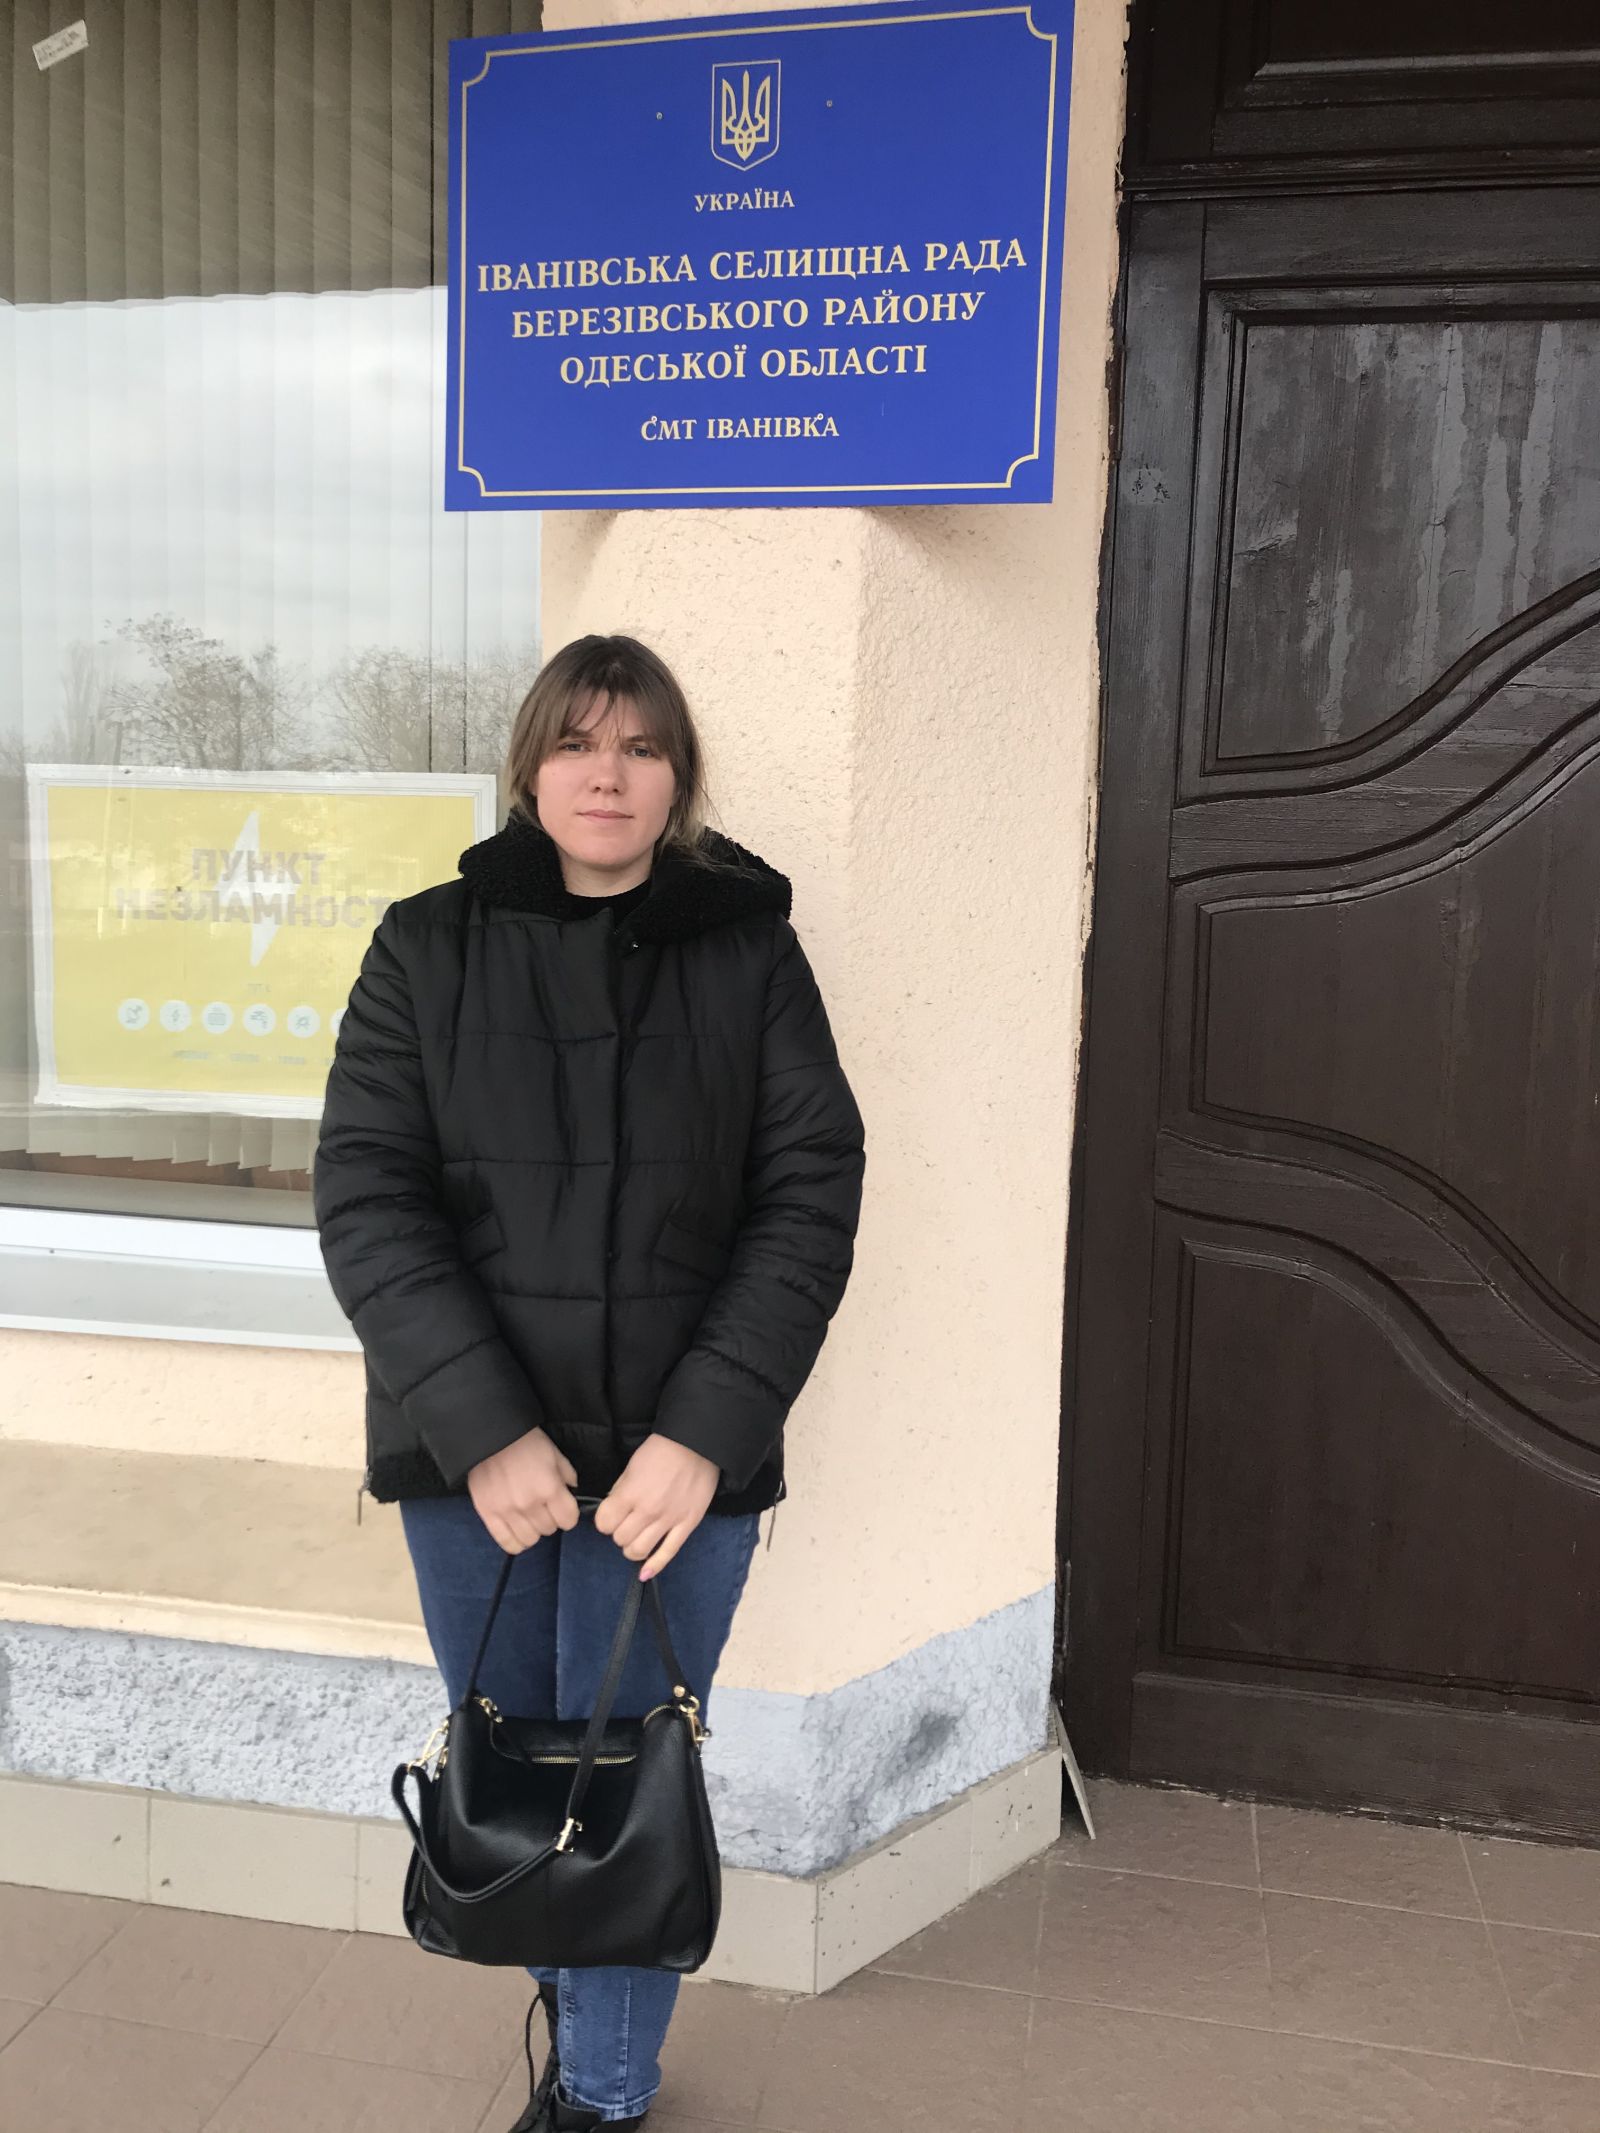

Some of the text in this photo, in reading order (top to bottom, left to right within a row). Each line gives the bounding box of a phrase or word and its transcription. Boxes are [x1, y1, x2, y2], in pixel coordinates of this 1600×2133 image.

[694, 189, 795, 212] УКРАЇНА
[478, 238, 1027, 292] ІВАНІВСЬКА СЕЛИЩНА РАДА
[512, 289, 986, 339] БЕРЕЗІВСЬКОГО РАЙОНУ
[559, 344, 927, 388] ОДЕСЬКОЇ ОБЛАСТІ
[641, 413, 840, 441] СМТ ІВАНІВКА
[191, 849, 326, 885] ПУНКТ
[114, 887, 396, 928] НЕЗЛАМНОСТ
